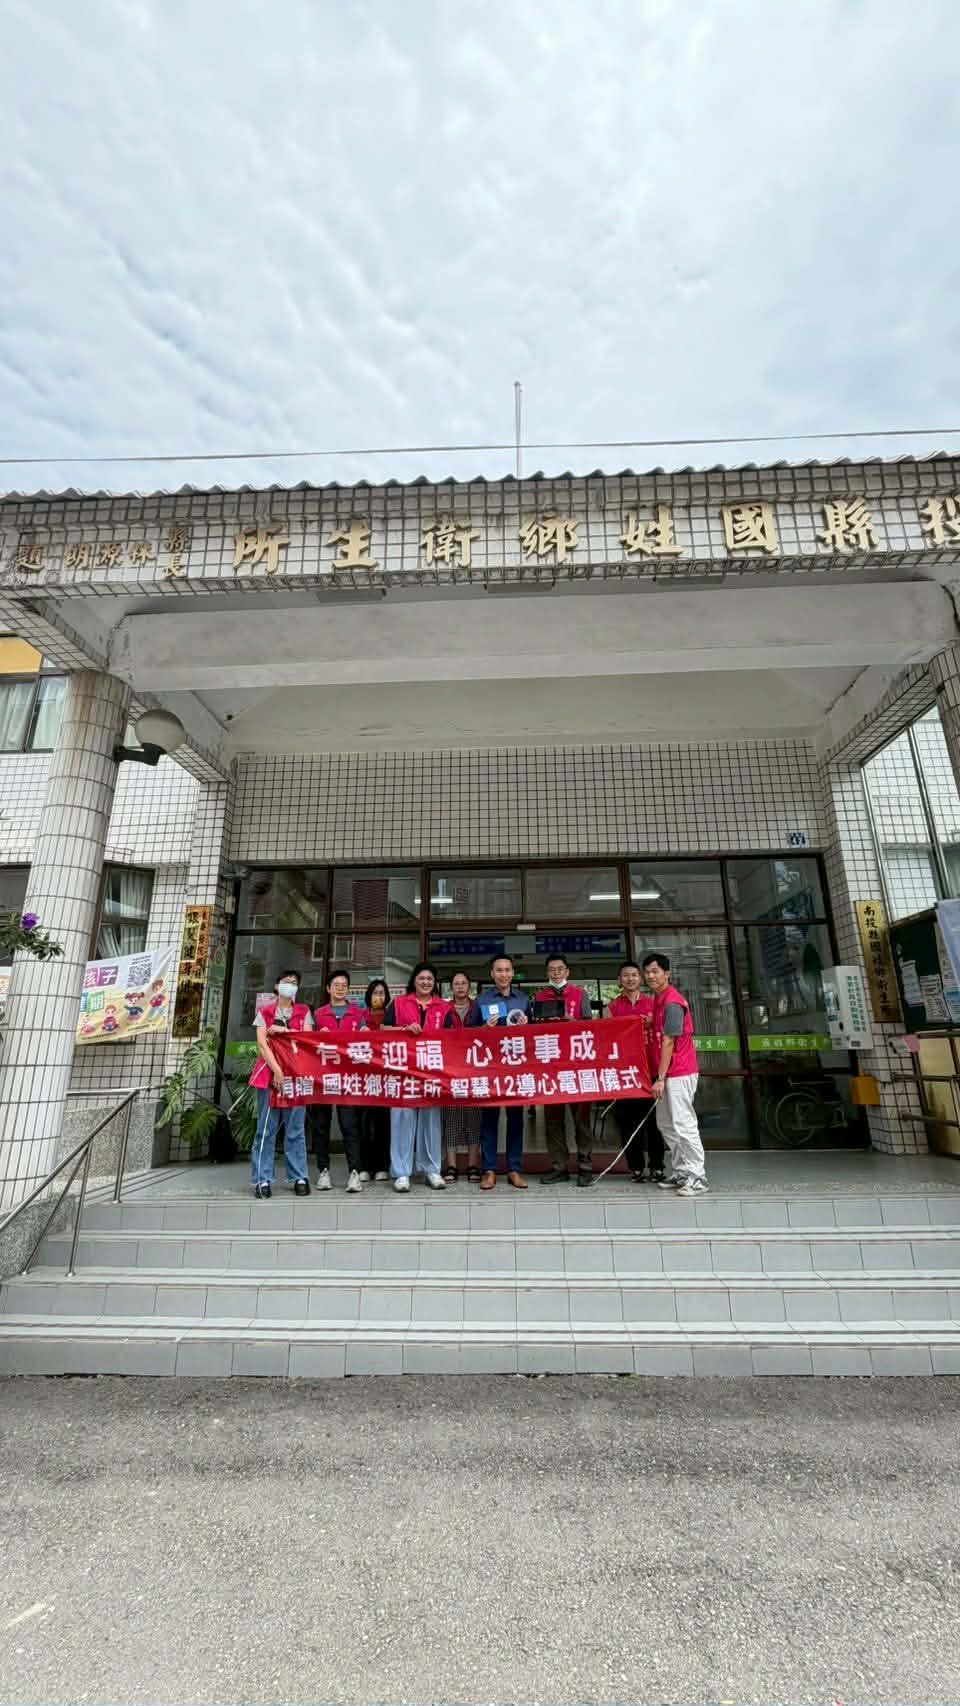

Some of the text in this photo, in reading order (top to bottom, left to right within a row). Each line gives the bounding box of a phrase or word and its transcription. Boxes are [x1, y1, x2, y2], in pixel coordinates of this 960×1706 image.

[466, 1030, 619, 1068] 心想事成」
[322, 1072, 442, 1099] 國姓鄉衛生所
[450, 1065, 641, 1099] 智慧12導心電圖儀式
